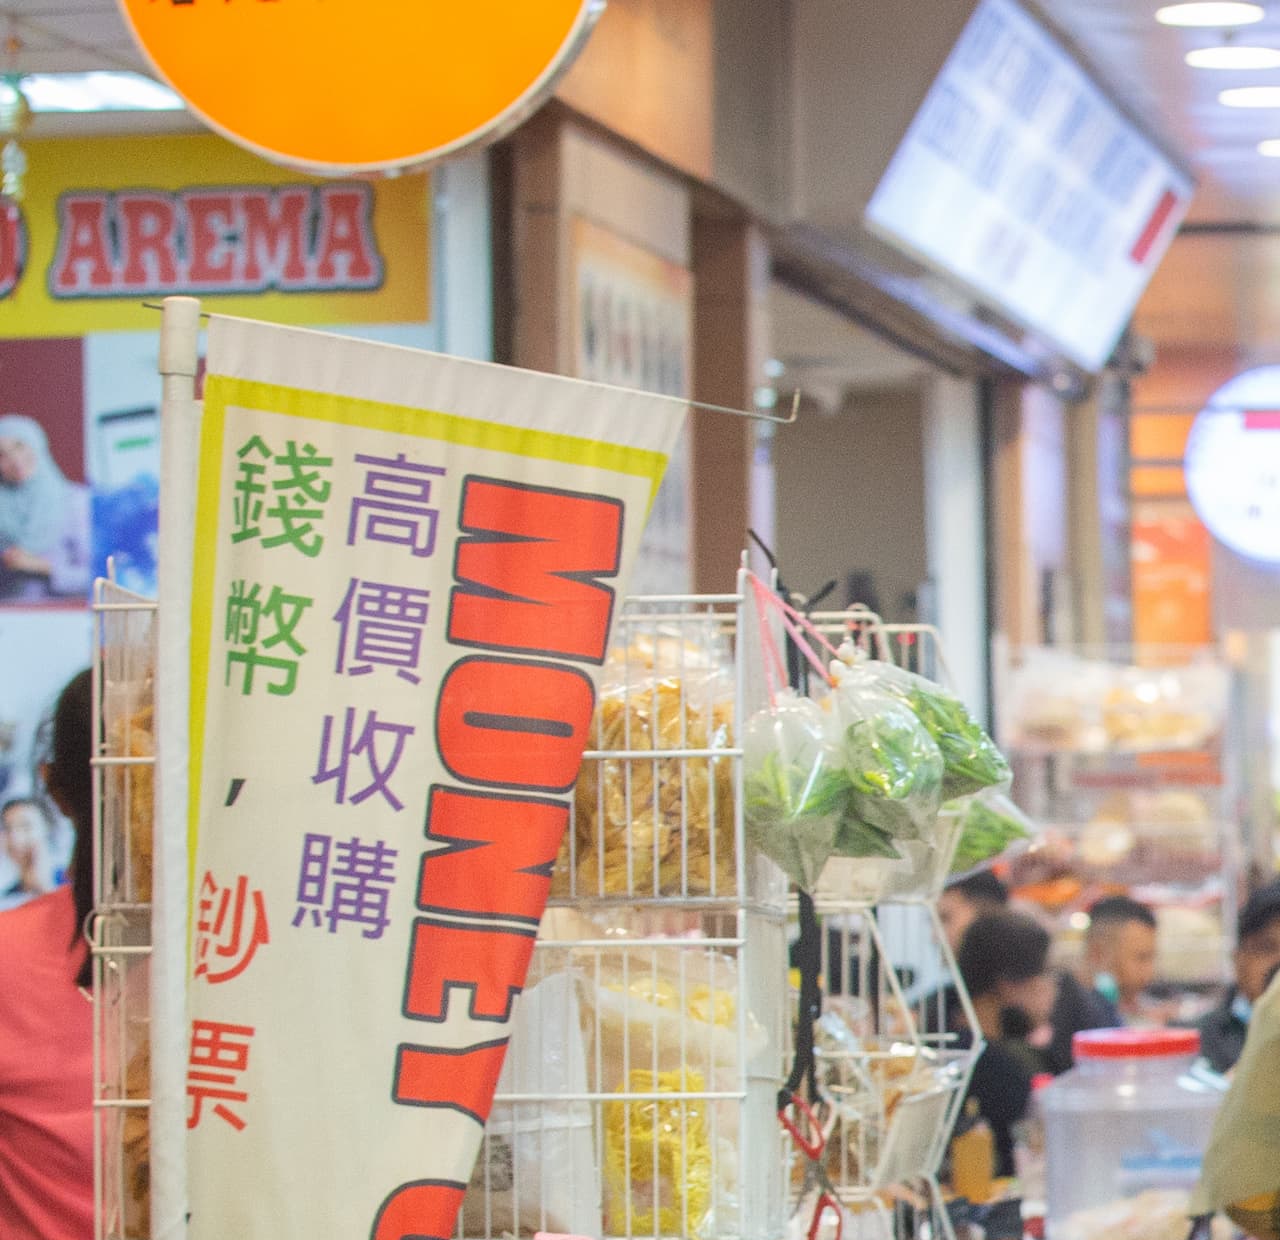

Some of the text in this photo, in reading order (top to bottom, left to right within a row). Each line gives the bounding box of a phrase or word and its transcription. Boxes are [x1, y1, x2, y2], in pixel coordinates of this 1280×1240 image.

[52, 187, 380, 297] AREMA
[291, 452, 447, 941] 高價收購
[391, 473, 625, 1128] MONEY
